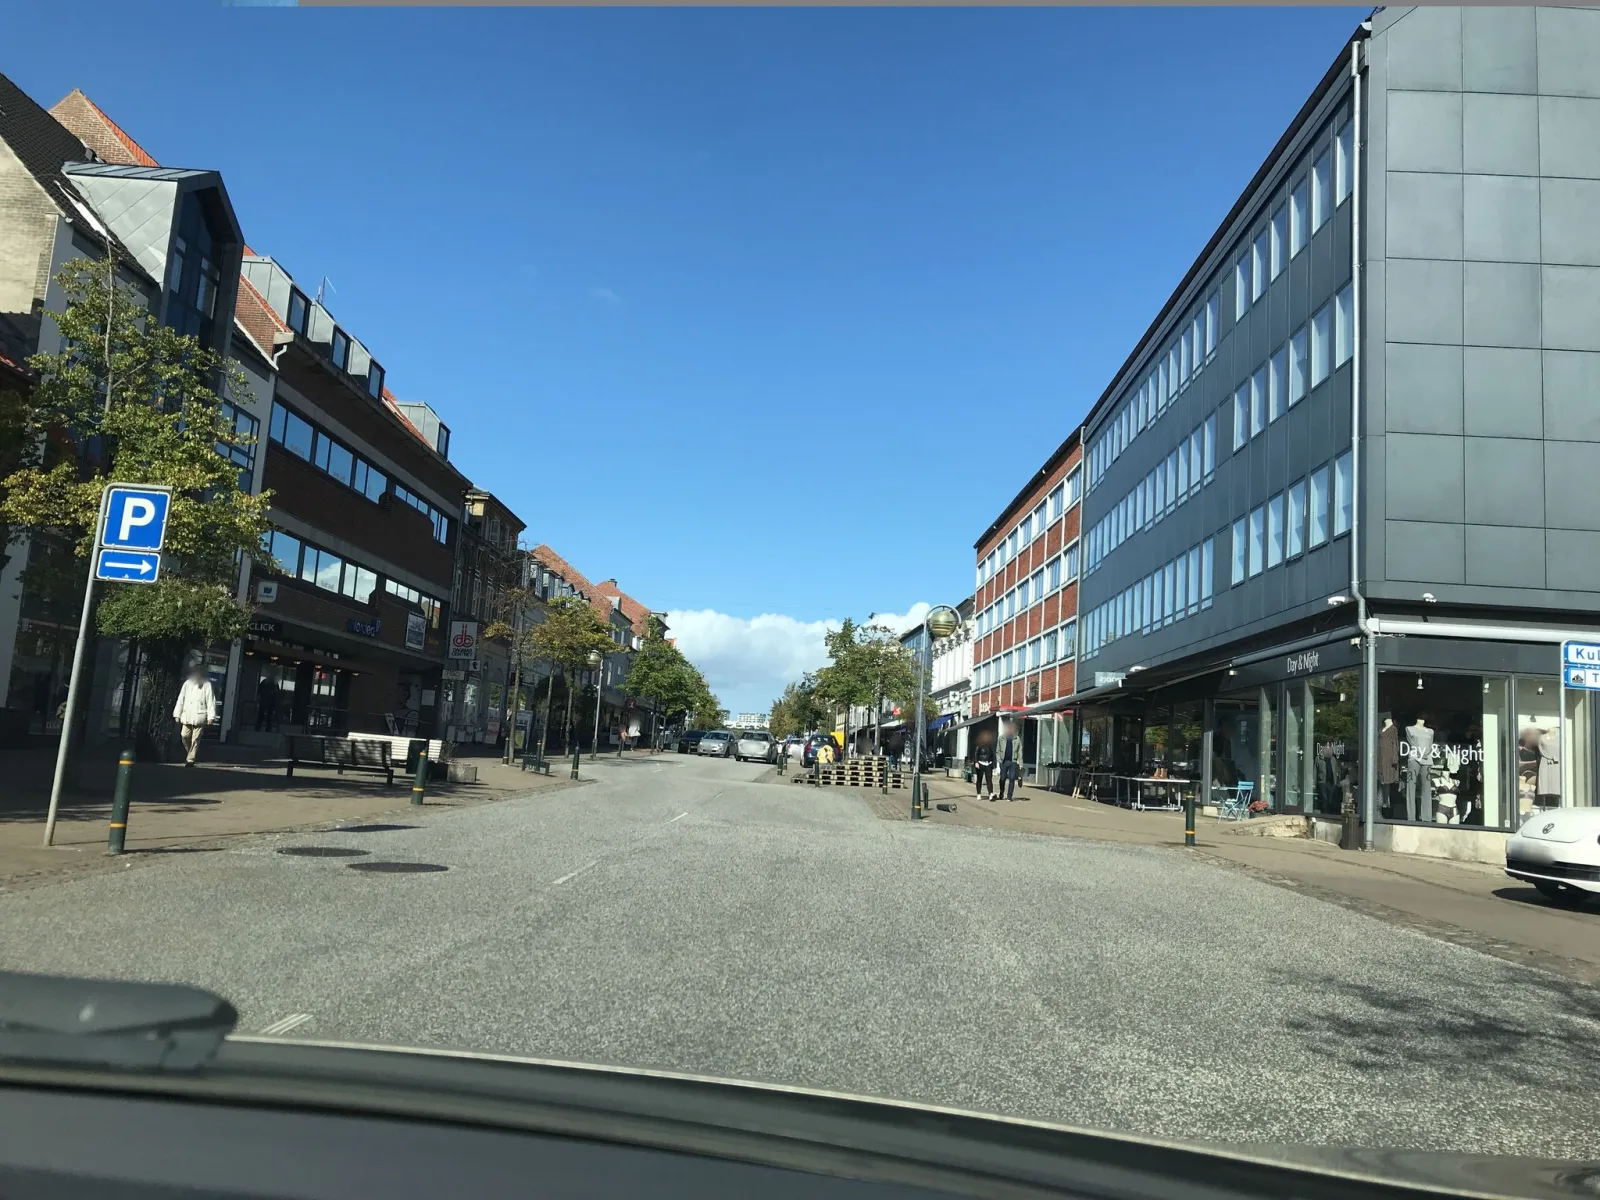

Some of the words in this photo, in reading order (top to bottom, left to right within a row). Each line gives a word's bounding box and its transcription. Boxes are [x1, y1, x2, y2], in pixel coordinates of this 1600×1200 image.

[119, 497, 156, 541] P
[1287, 657, 1298, 676] Day
[1298, 654, 1303, 671] &
[1303, 650, 1319, 673] Night
[1399, 741, 1427, 762] Day
[1430, 743, 1441, 759] &
[1444, 744, 1485, 765] Night
